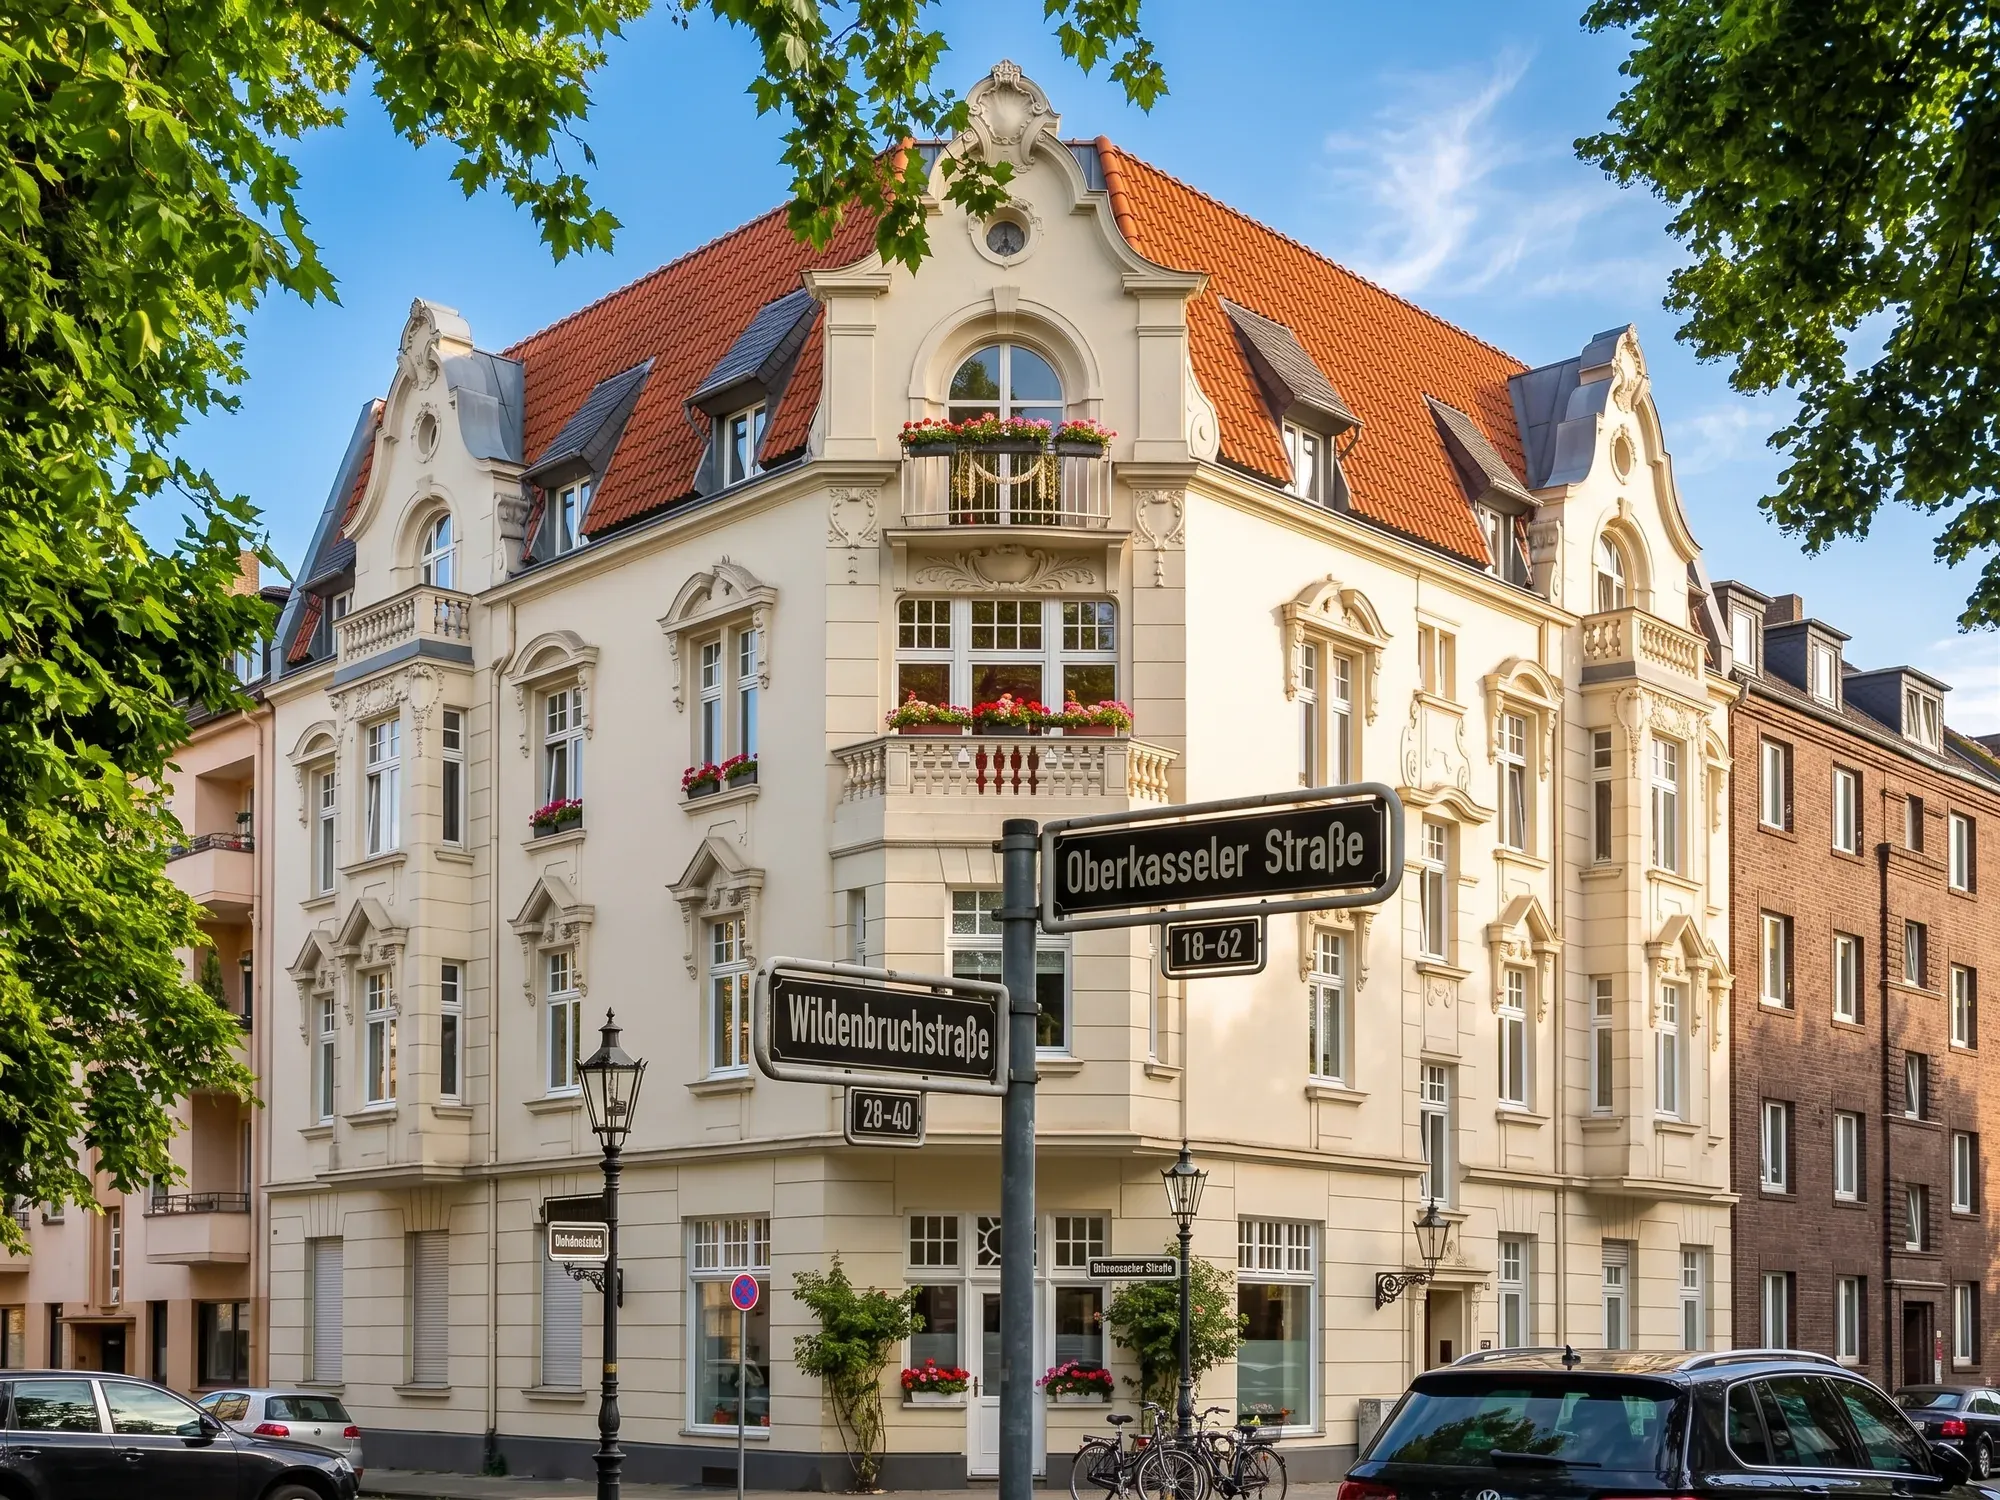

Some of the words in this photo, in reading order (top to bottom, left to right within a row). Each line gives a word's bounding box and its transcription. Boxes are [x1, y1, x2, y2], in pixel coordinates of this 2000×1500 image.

[1067, 836, 1249, 894] Oberkasseler
[1265, 821, 1364, 873] Straße
[1181, 928, 1242, 962] 18-62
[788, 993, 989, 1064] Wildenbruchstraße
[863, 1098, 912, 1130] 28-40
